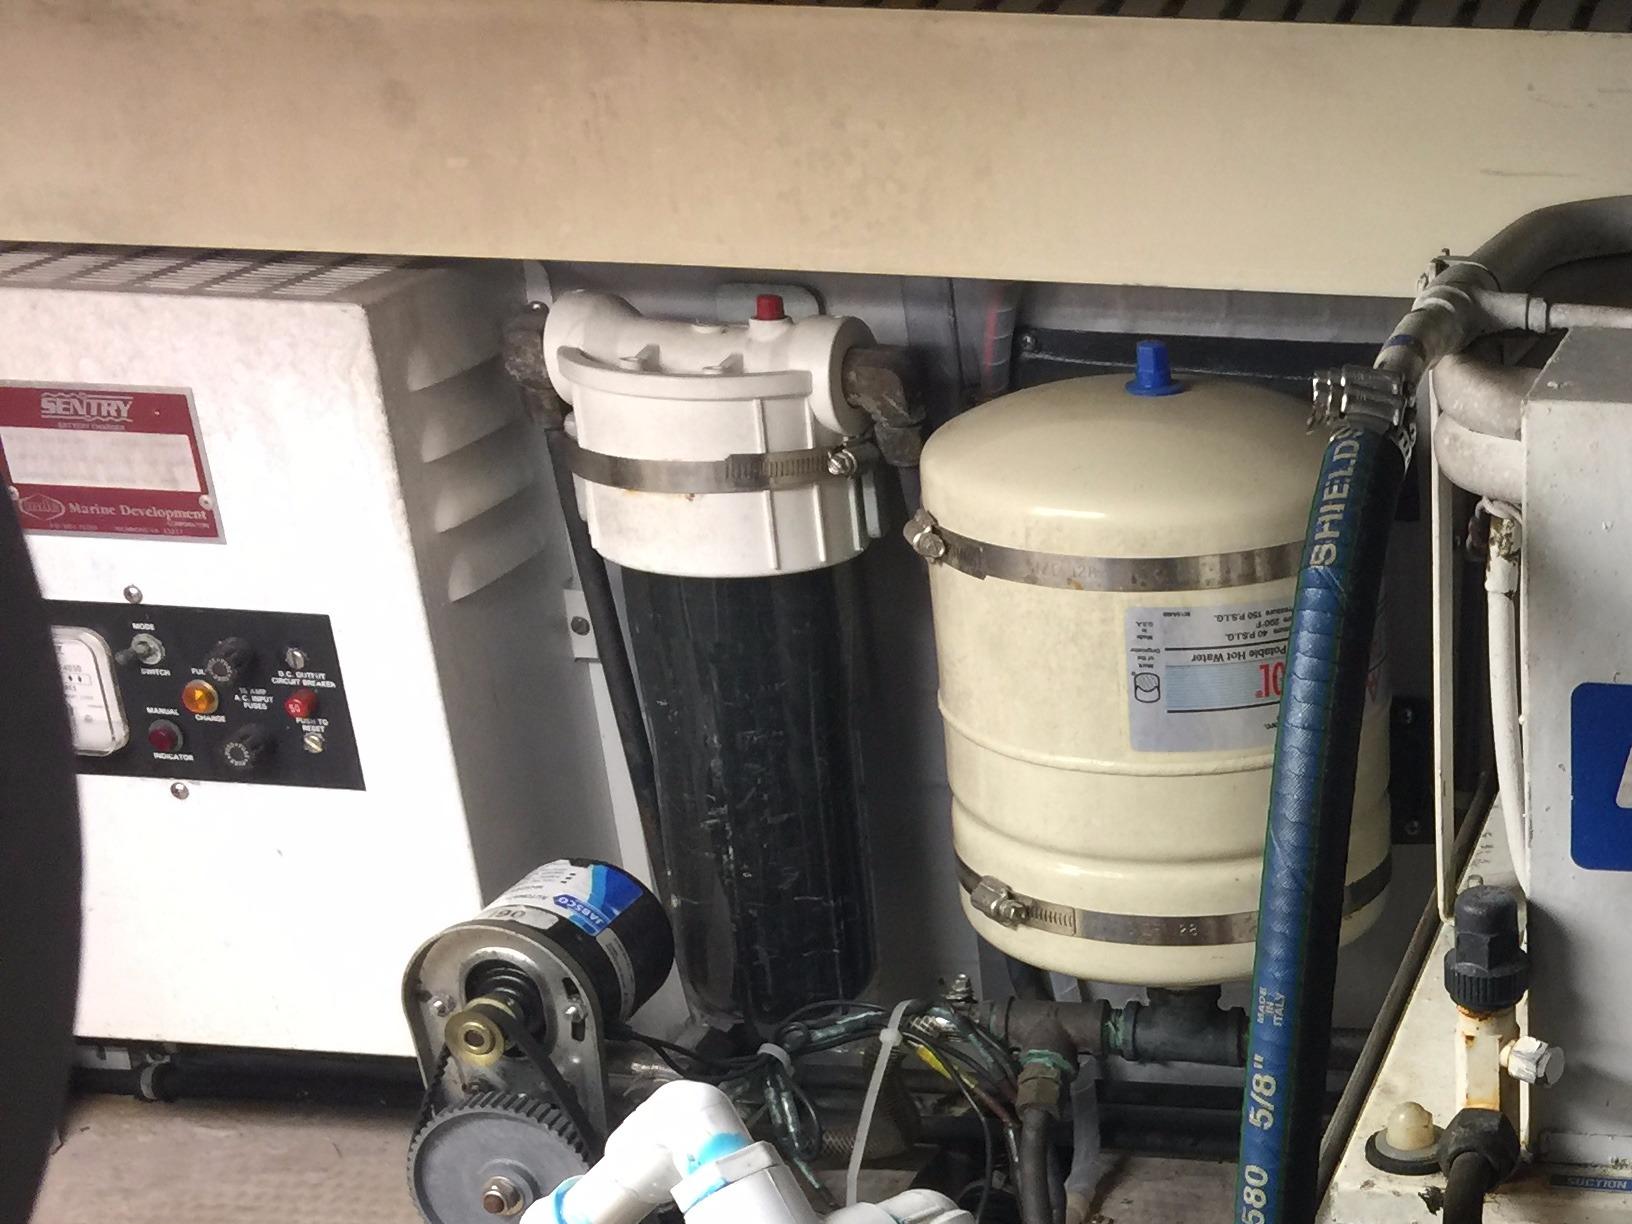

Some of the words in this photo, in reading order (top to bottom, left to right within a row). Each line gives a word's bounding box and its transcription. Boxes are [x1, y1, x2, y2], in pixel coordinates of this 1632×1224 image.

[41, 397, 133, 418] SENTRY
[69, 503, 115, 516] Marine
[121, 505, 208, 521] Development
[132, 623, 155, 631] MODE
[1227, 651, 1246, 661] Hot
[1249, 645, 1287, 659] Potable
[1191, 653, 1224, 663] Water
[141, 668, 171, 676] SWITCH
[191, 668, 206, 676] FUL
[271, 678, 300, 686] CIRCUIT
[302, 679, 336, 688] BREAKER
[243, 702, 268, 710] FUSES
[147, 707, 179, 716] MANUAL
[154, 752, 194, 761] INDICATOR
[558, 896, 606, 925] JABSCO
[1256, 986, 1267, 1024] MADE
[1264, 1000, 1275, 1016] IN
[1273, 991, 1287, 1027] ITALY
[1248, 1055, 1279, 1131] 5/8"
[1568, 1178, 1627, 1188] SUCTION
